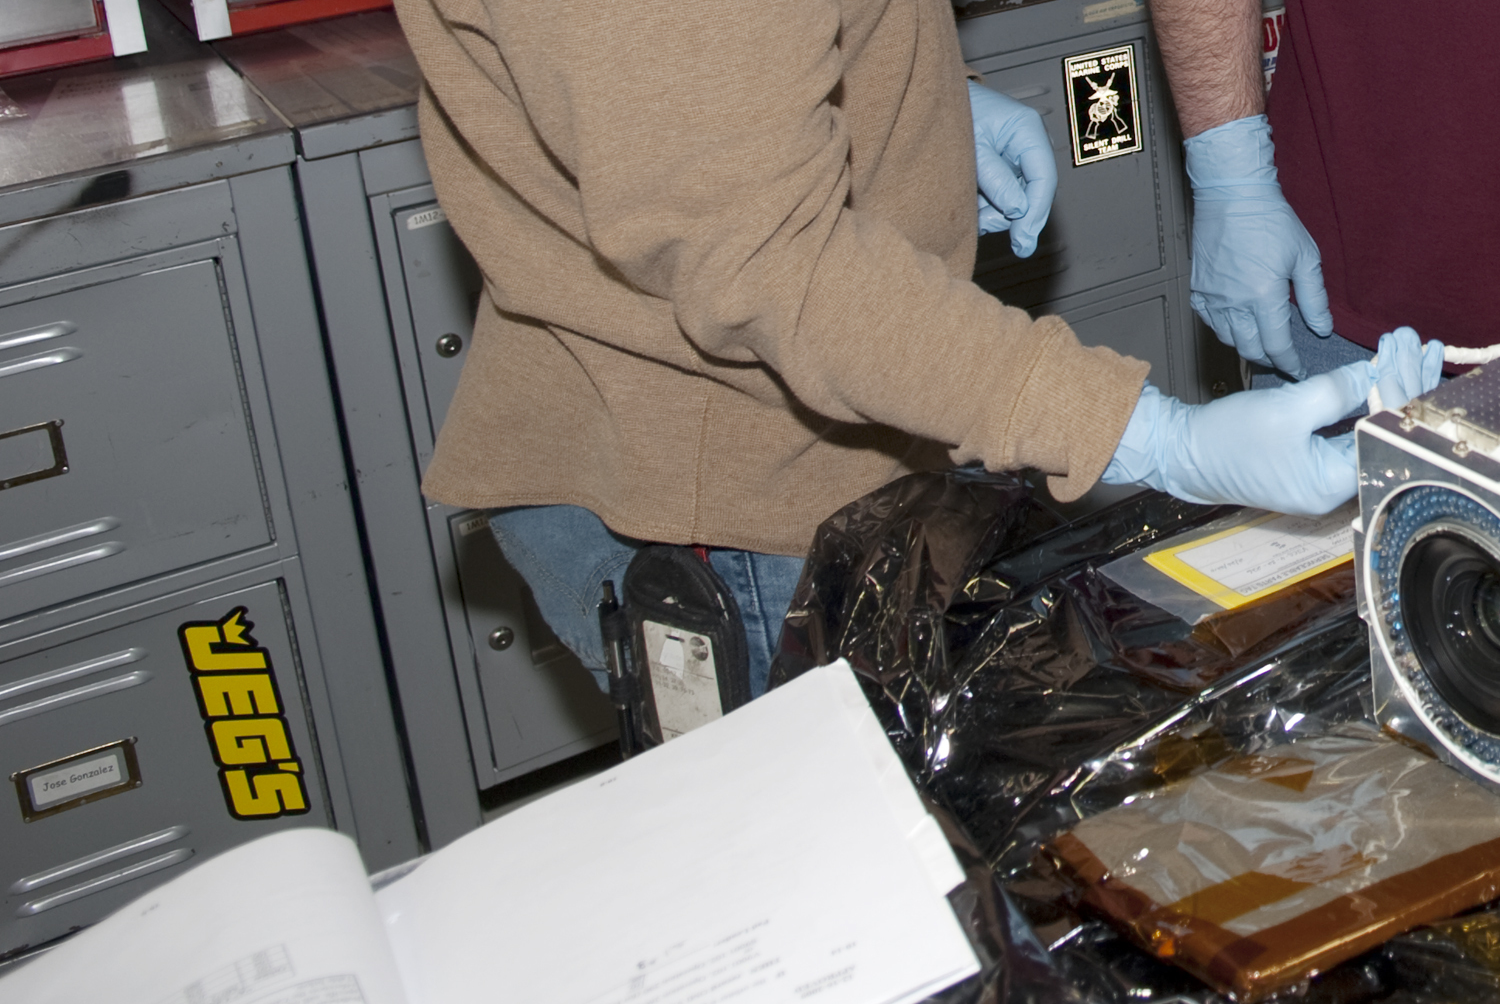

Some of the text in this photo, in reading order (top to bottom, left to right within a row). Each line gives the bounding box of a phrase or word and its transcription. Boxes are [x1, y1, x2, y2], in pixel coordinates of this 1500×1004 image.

[1071, 53, 1128, 71] UNITED STATES
[1071, 61, 1129, 78] MARINE CORPS
[1083, 134, 1132, 151] SILENT DRILL
[1098, 144, 1119, 154] TEAM
[178, 608, 311, 820] JEG'S
[42, 765, 114, 792] Jose Gonzalez
